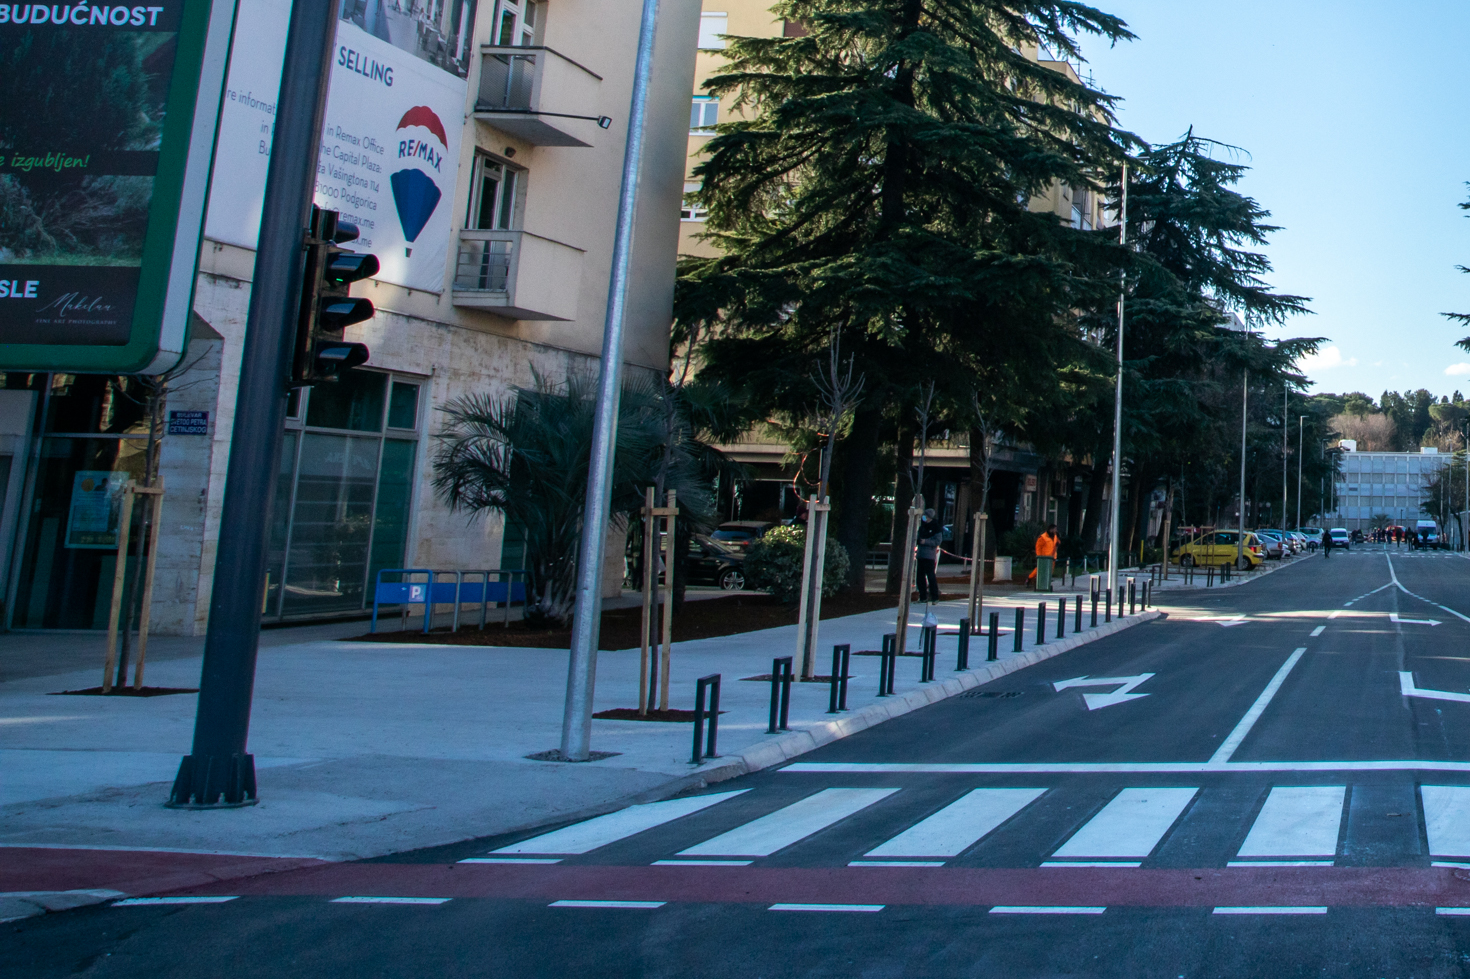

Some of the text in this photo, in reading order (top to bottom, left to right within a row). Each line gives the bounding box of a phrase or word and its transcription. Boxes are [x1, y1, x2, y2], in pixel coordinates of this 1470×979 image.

[0, 0, 164, 26] BUDUĆNOST
[338, 46, 394, 87] SELLING
[239, 90, 276, 115] informat
[261, 120, 269, 134] in
[326, 123, 384, 156] in Remax Office
[11, 152, 90, 172] izgubljen!
[333, 145, 360, 166] Capital
[362, 155, 382, 174] Plaza:
[398, 139, 443, 173] RE/MAX
[328, 163, 369, 188] Vašingtona
[341, 187, 377, 211] Podgorica
[411, 585, 421, 599] P
